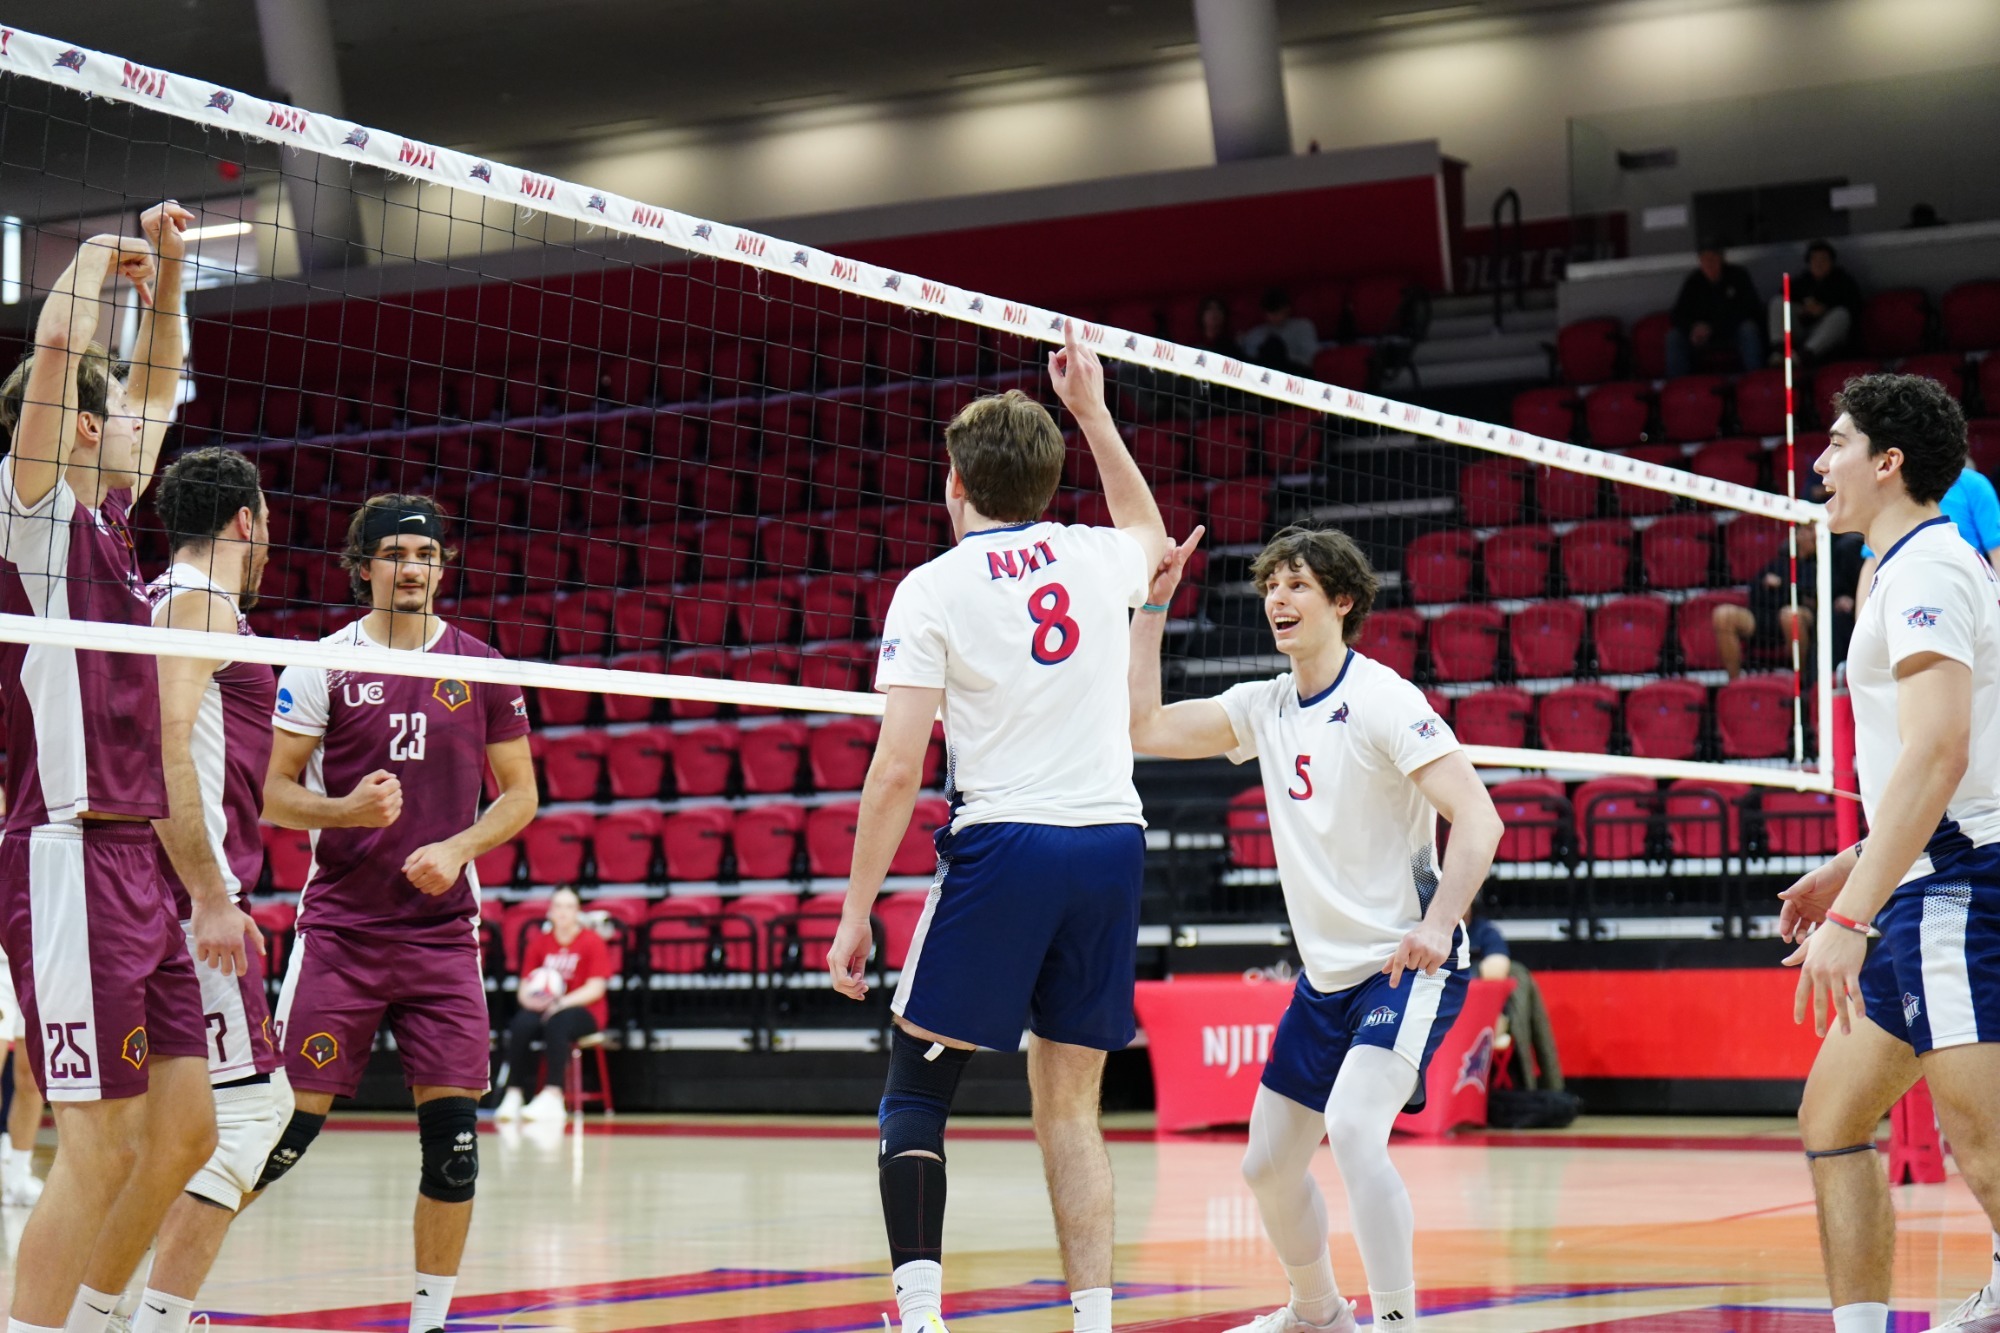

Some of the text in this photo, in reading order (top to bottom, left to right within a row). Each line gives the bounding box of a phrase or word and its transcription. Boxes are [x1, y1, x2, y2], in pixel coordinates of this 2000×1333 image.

[121, 60, 168, 99] NJIT
[266, 102, 310, 135] NJIT
[399, 139, 437, 170] NJIT
[519, 172, 556, 201] NJIT
[631, 204, 666, 230] NJIT
[735, 233, 767, 257] NJIT
[830, 258, 861, 283] NJIT
[920, 281, 948, 305] NJIT
[1002, 303, 1029, 326] NJIT
[986, 536, 1058, 582] NJIT
[1027, 582, 1080, 666] 8
[343, 681, 385, 708] UC
[389, 712, 427, 761] 23
[1288, 754, 1314, 801] 5
[1365, 1012, 1396, 1028] NJIT
[46, 1021, 92, 1079] 25
[1202, 1024, 1275, 1079] NJIT
